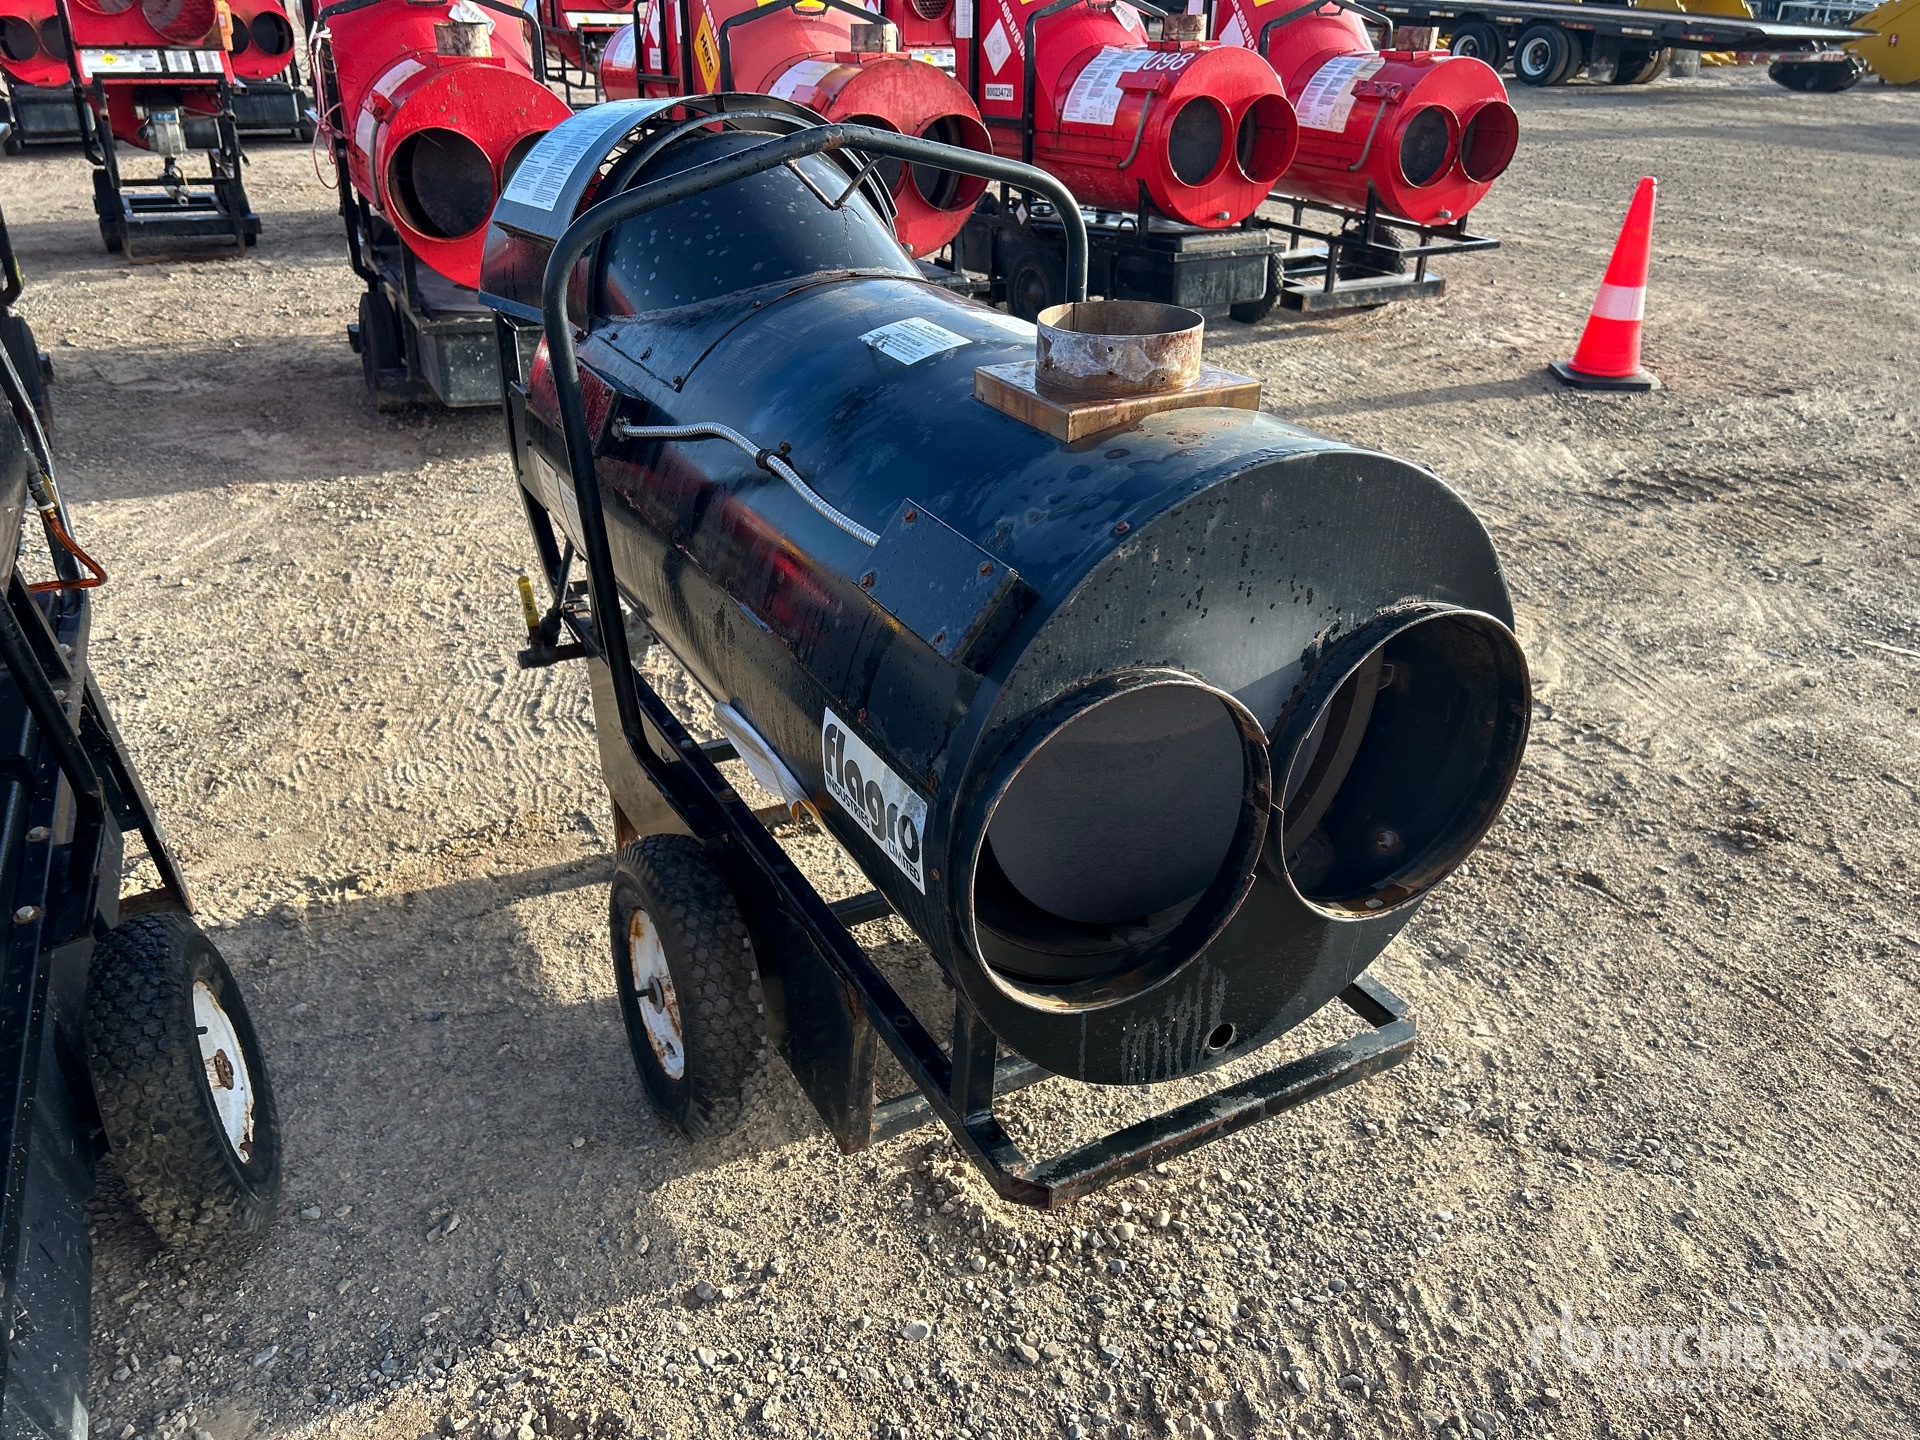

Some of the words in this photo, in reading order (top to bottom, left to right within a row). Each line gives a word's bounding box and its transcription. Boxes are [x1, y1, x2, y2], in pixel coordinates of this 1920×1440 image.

[1001, 1, 1013, 24] 400
[1009, 20, 1021, 45] D/G
[1237, 9, 1247, 31] 400
[1244, 27, 1255, 50] D/G
[700, 33, 714, 74] Herc
[1143, 52, 1196, 71] 098
[824, 723, 920, 864] flagro
[826, 772, 870, 829] INDUSTRIES
[887, 839, 920, 883] LIMITED
